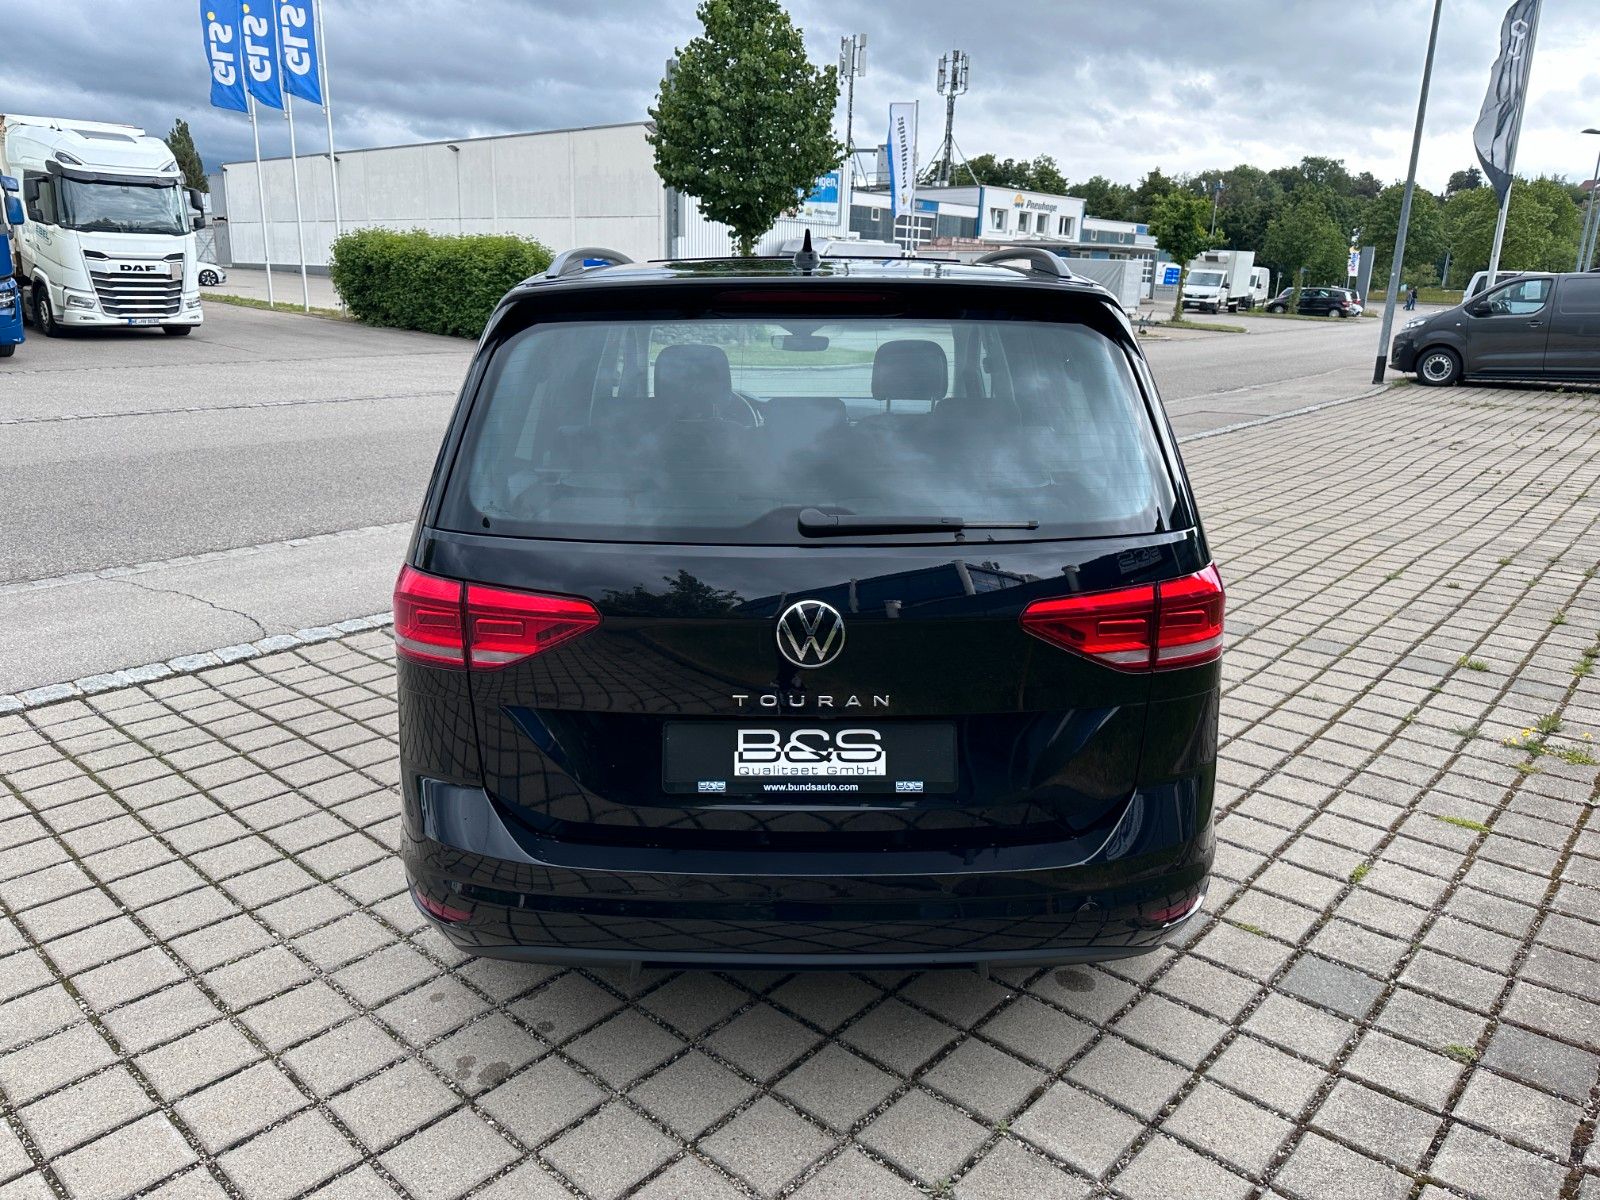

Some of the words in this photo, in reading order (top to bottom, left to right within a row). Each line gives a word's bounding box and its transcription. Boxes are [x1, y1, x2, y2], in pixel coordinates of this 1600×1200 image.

[1026, 199, 1058, 213] Pneuhage
[120, 264, 156, 272] DAF
[779, 601, 844, 665] VW
[732, 694, 890, 708] TOURAN
[737, 728, 882, 763] B&S
[738, 764, 818, 776] Qualitaet
[763, 782, 859, 792] www.bundsauto.com
